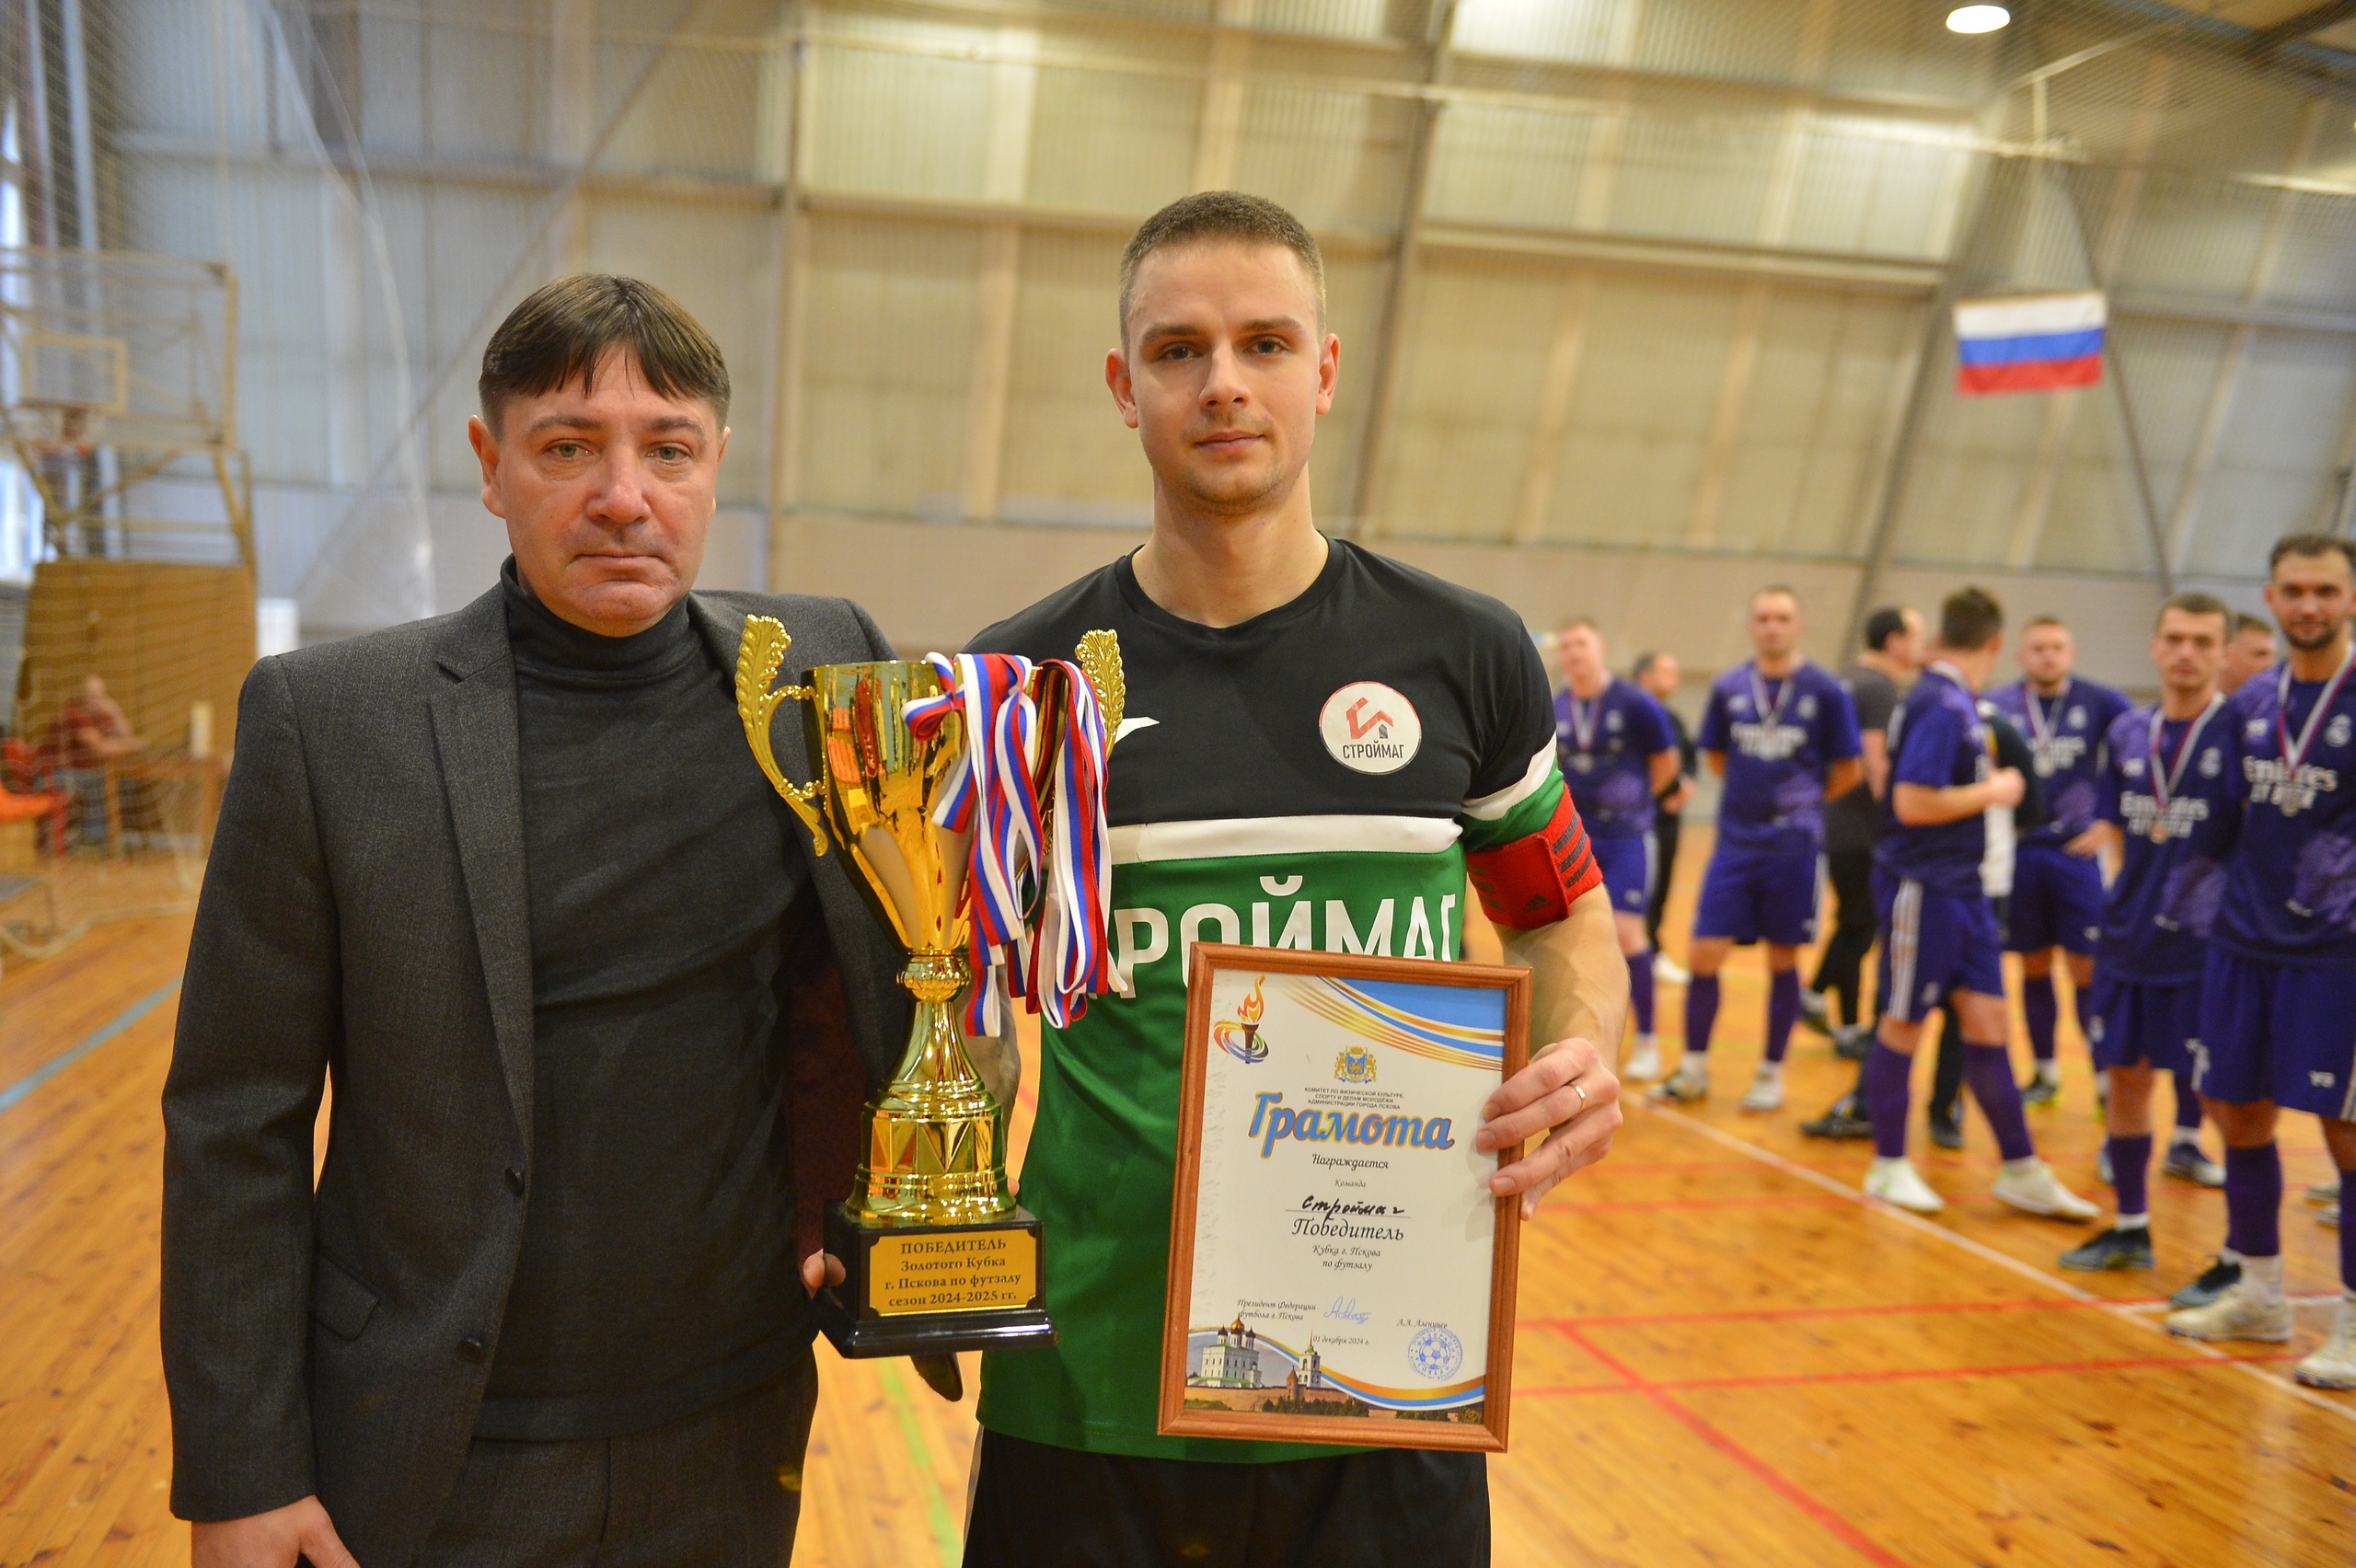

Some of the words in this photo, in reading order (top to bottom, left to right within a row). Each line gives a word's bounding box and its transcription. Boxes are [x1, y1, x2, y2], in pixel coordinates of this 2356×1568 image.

[1343, 740, 1404, 759] СТРОЙМАГ
[1114, 875, 1456, 998] РОЙМАГ
[1340, 1089, 1377, 1097] ФИЗИЧЕСКОЙ
[1249, 1091, 1456, 1159] Грамота
[1311, 1153, 1389, 1171] Награждается
[1334, 1179, 1367, 1188] Команда
[1291, 1217, 1404, 1241] Победитель
[900, 1238, 1007, 1256] ПОБЕДИТЕЛЬ
[1311, 1244, 1339, 1257] Кубка
[1349, 1247, 1381, 1258] Пскова
[901, 1258, 964, 1272] Золотого
[966, 1256, 1006, 1271] Кубка
[1322, 1260, 1333, 1268] по
[1334, 1258, 1373, 1273] футзалу
[884, 1280, 895, 1290] г.
[898, 1276, 947, 1290] Пскова
[950, 1276, 967, 1286] по
[969, 1273, 1022, 1290] футзалу
[889, 1295, 927, 1308] сезон
[930, 1291, 999, 1306] 2024-2025
[1001, 1291, 1017, 1301] гг.
[1237, 1298, 1276, 1309] Президент
[1277, 1301, 1317, 1312] Федерации
[1277, 1311, 1304, 1321] Пскова
[1322, 1336, 1347, 1346] декабря
